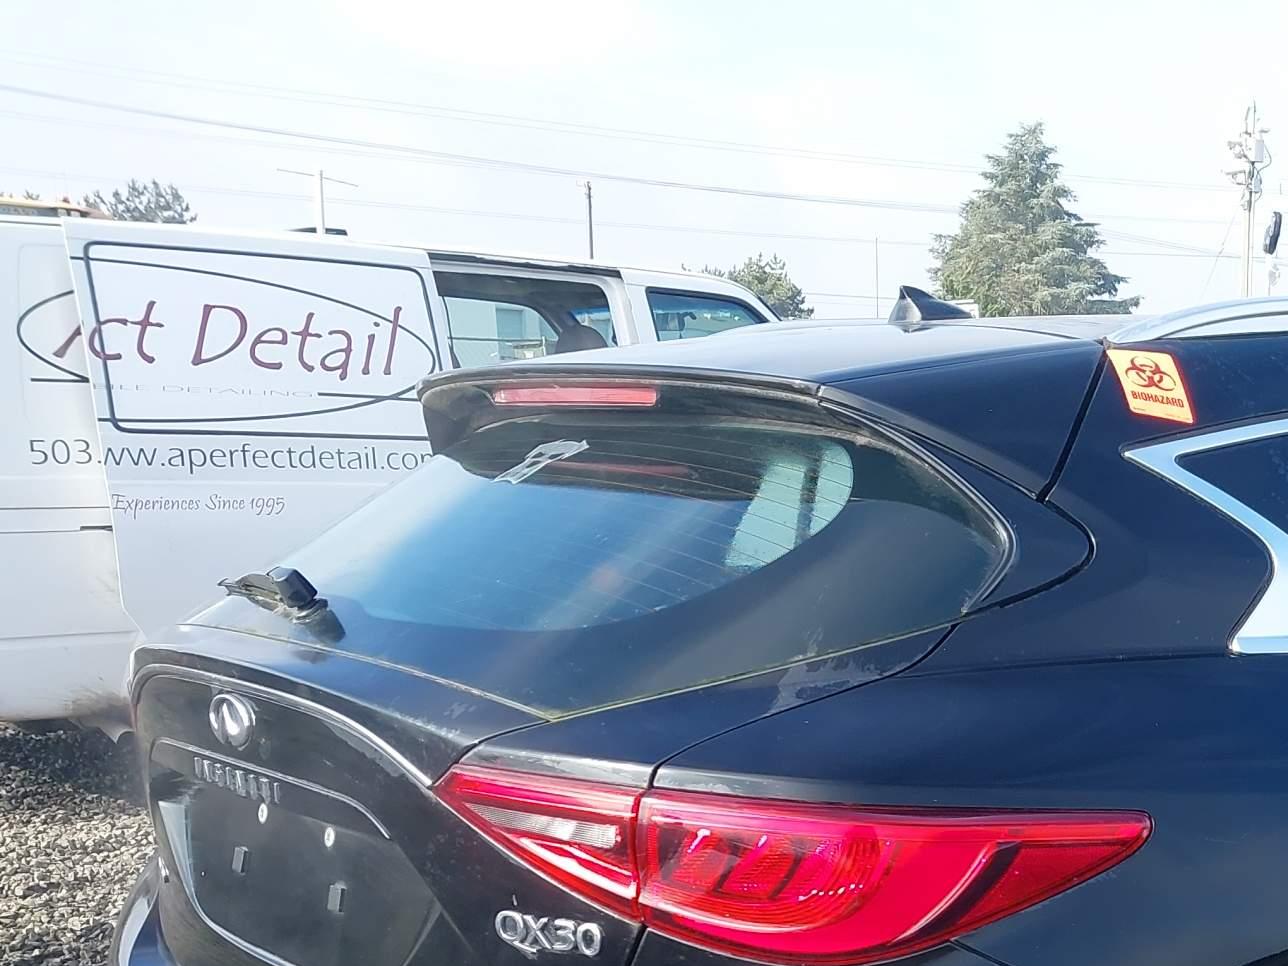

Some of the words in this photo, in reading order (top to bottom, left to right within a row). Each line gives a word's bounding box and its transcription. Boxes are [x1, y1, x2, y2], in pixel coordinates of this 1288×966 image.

[191, 303, 402, 381] Detail
[1131, 390, 1185, 408] BIOHAZARD
[111, 493, 201, 520] Experiences
[205, 493, 246, 511] Since
[249, 497, 286, 516] 1995
[495, 910, 602, 958] QX30
